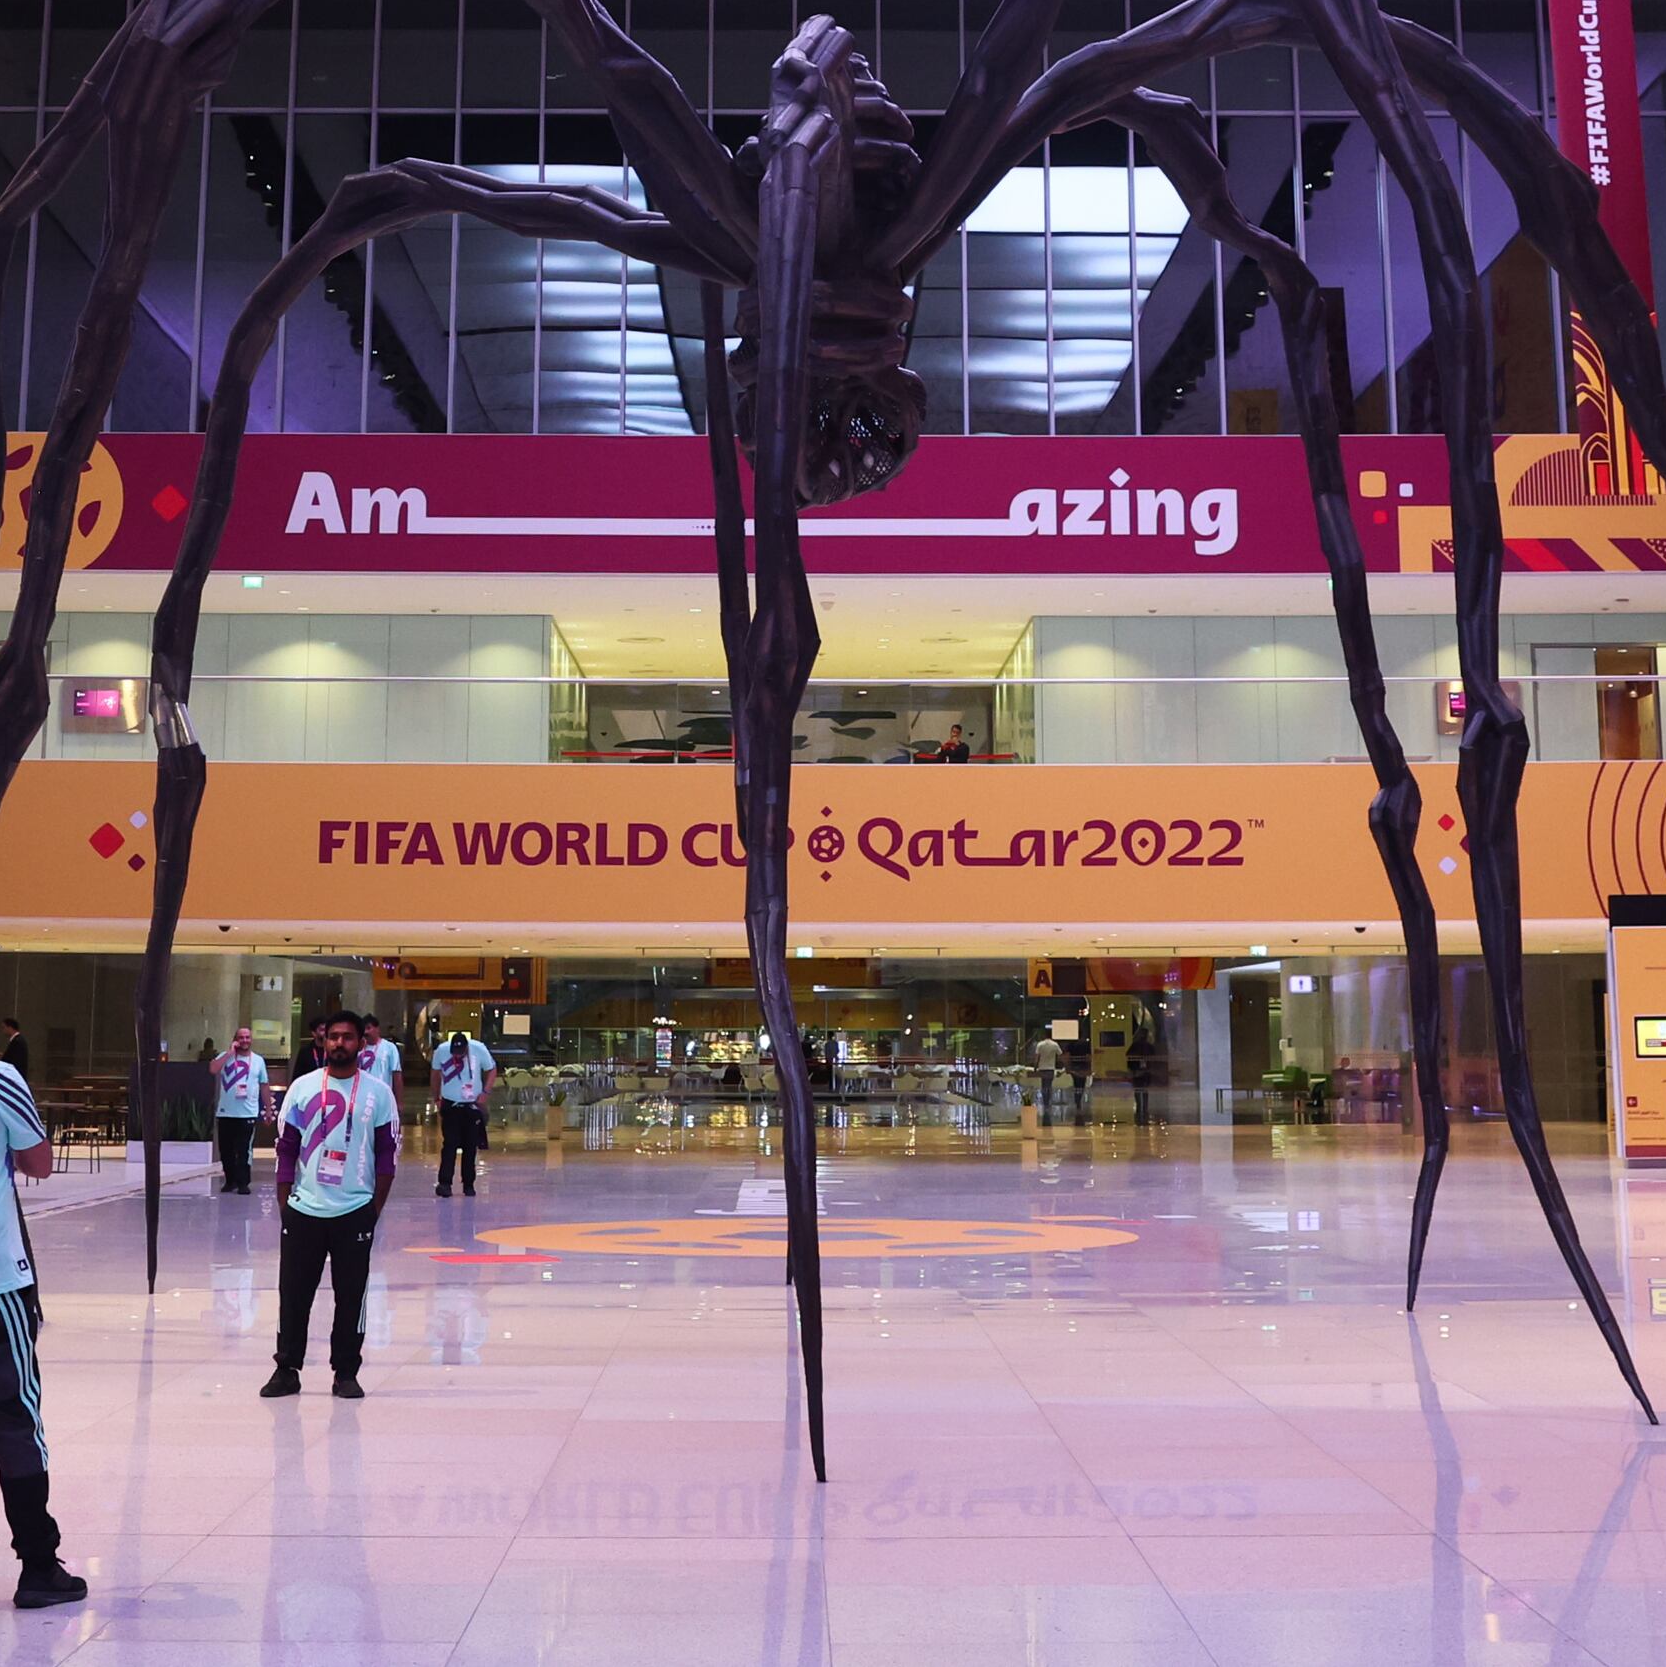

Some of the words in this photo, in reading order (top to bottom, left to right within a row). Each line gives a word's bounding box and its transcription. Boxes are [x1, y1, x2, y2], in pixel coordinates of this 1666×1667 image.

[318, 820, 451, 866] FIFA
[453, 821, 669, 867] WORLD
[857, 817, 1245, 882] Qatar2022
